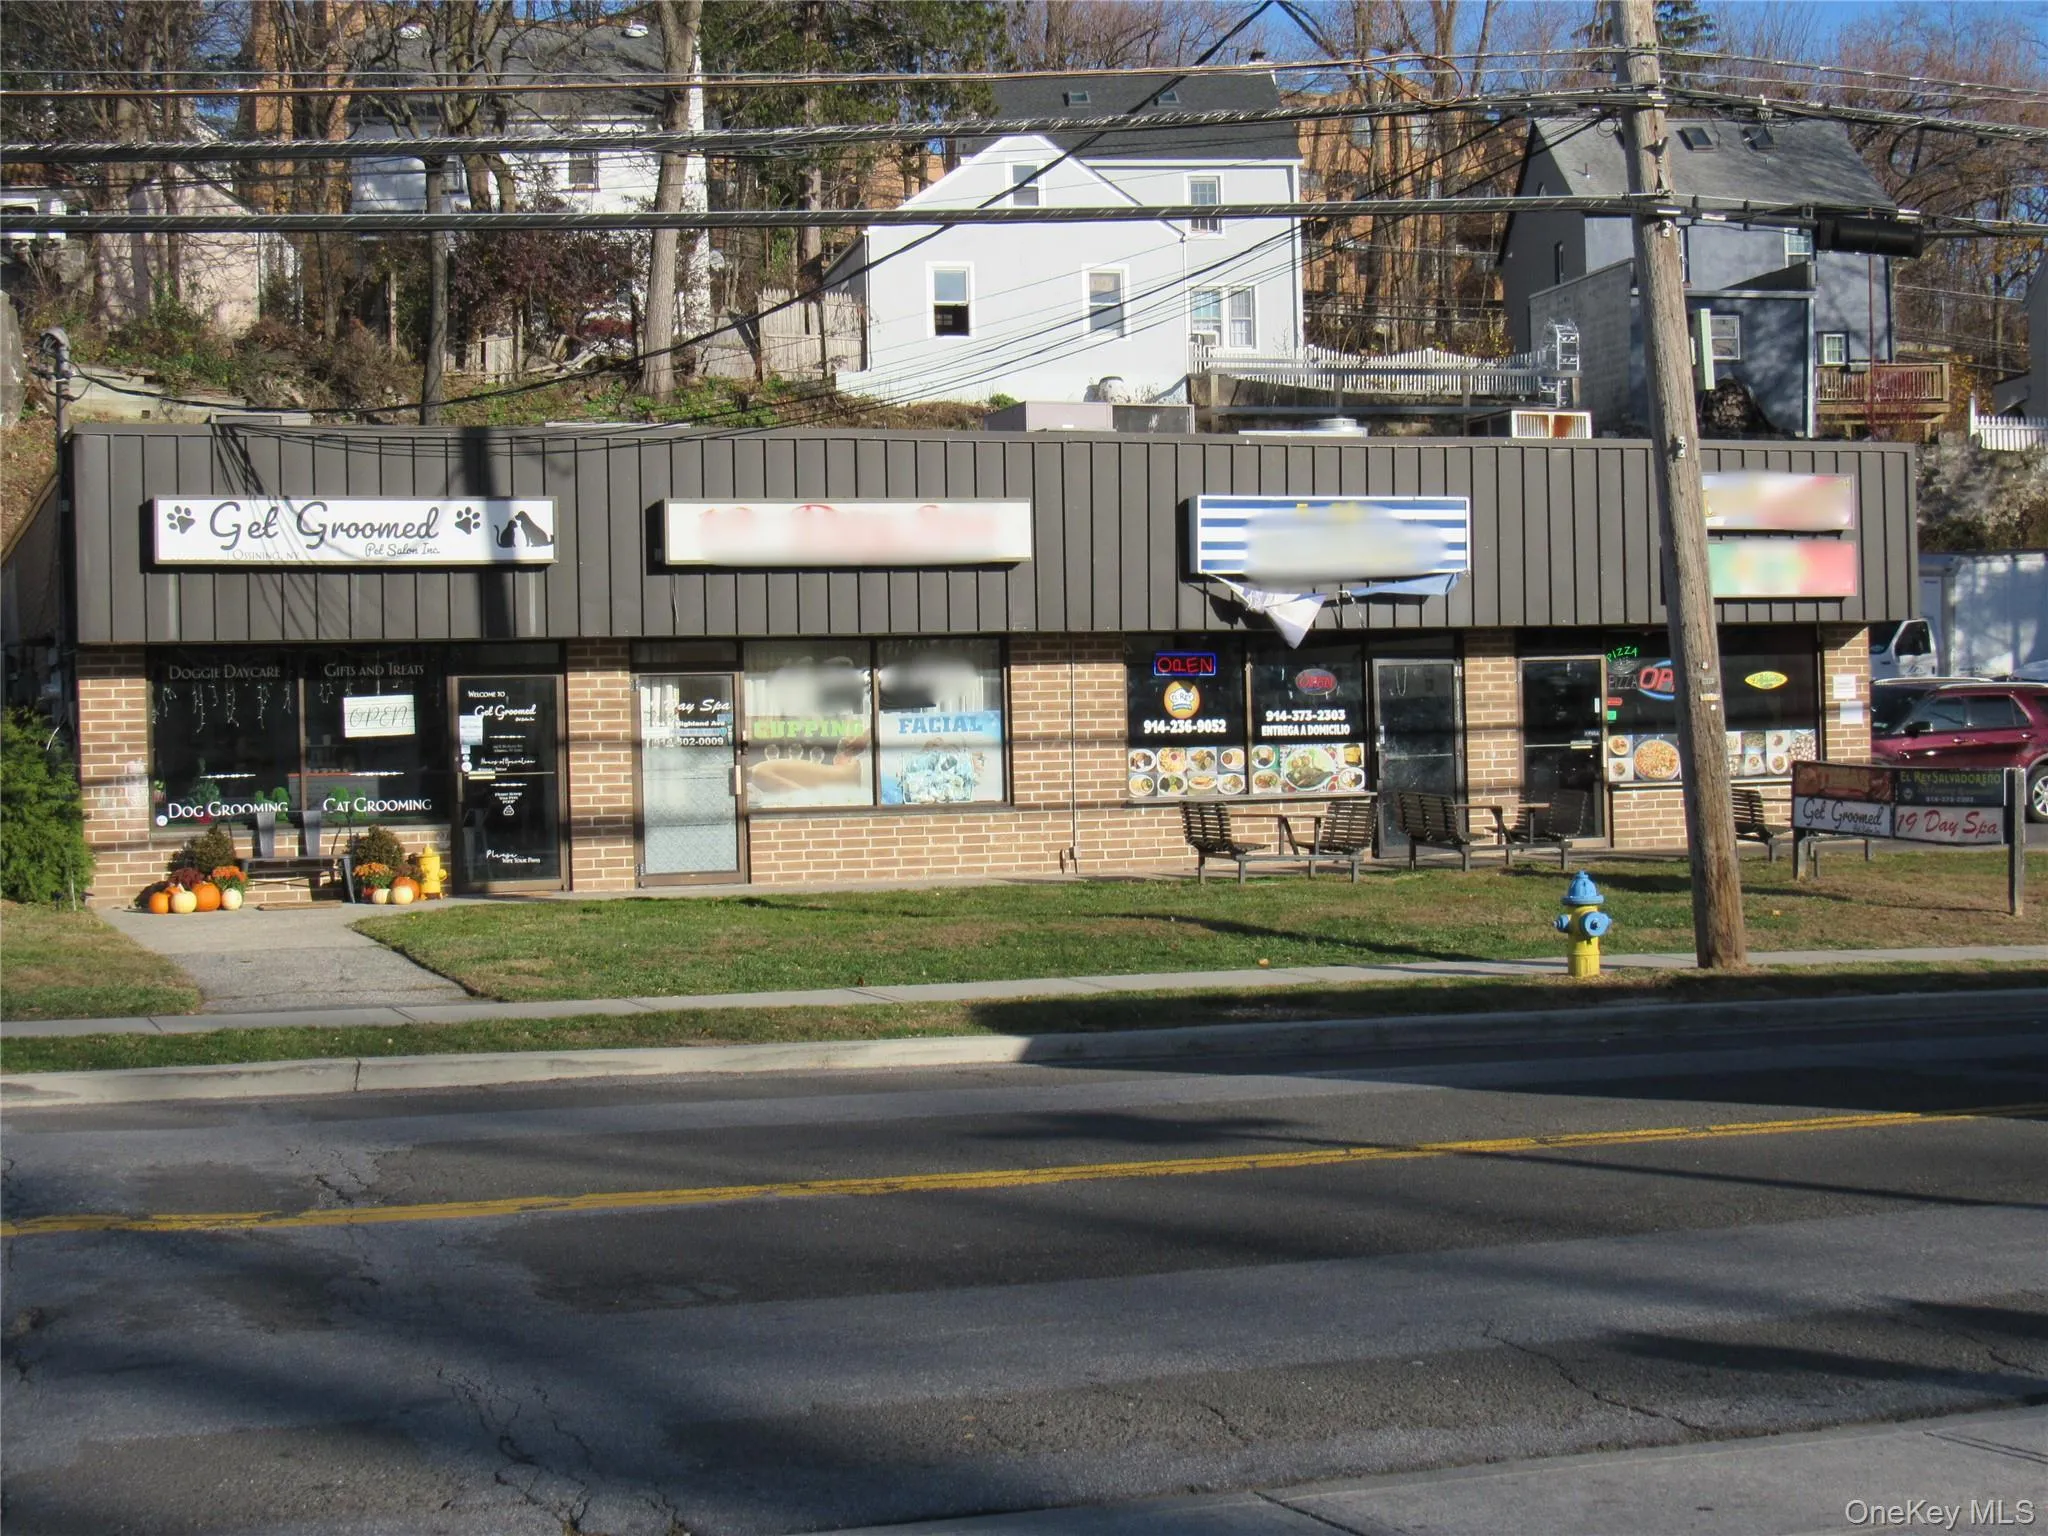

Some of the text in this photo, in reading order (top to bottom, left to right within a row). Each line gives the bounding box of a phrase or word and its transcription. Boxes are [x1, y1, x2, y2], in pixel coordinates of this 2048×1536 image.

[208, 501, 440, 551] Get Groomed
[364, 543, 382, 557] Pet
[387, 544, 418, 557] Salon
[1606, 646, 1638, 663] PIZZA
[1157, 656, 1213, 674] OPEN
[494, 703, 537, 721] Groomed
[699, 698, 731, 714] Spa
[1265, 708, 1347, 723] 914-373-2303
[753, 719, 865, 739] CUPPING
[898, 715, 985, 734] FACIAL
[1143, 718, 1227, 734] 914-236-9052
[1261, 723, 1351, 737] ENTREGA A DOMICILIO
[167, 802, 205, 819] DOG
[354, 797, 433, 814] GROOMING
[1802, 797, 1885, 829] Get Groomed
[1896, 809, 1999, 839] 19 Day Spa
